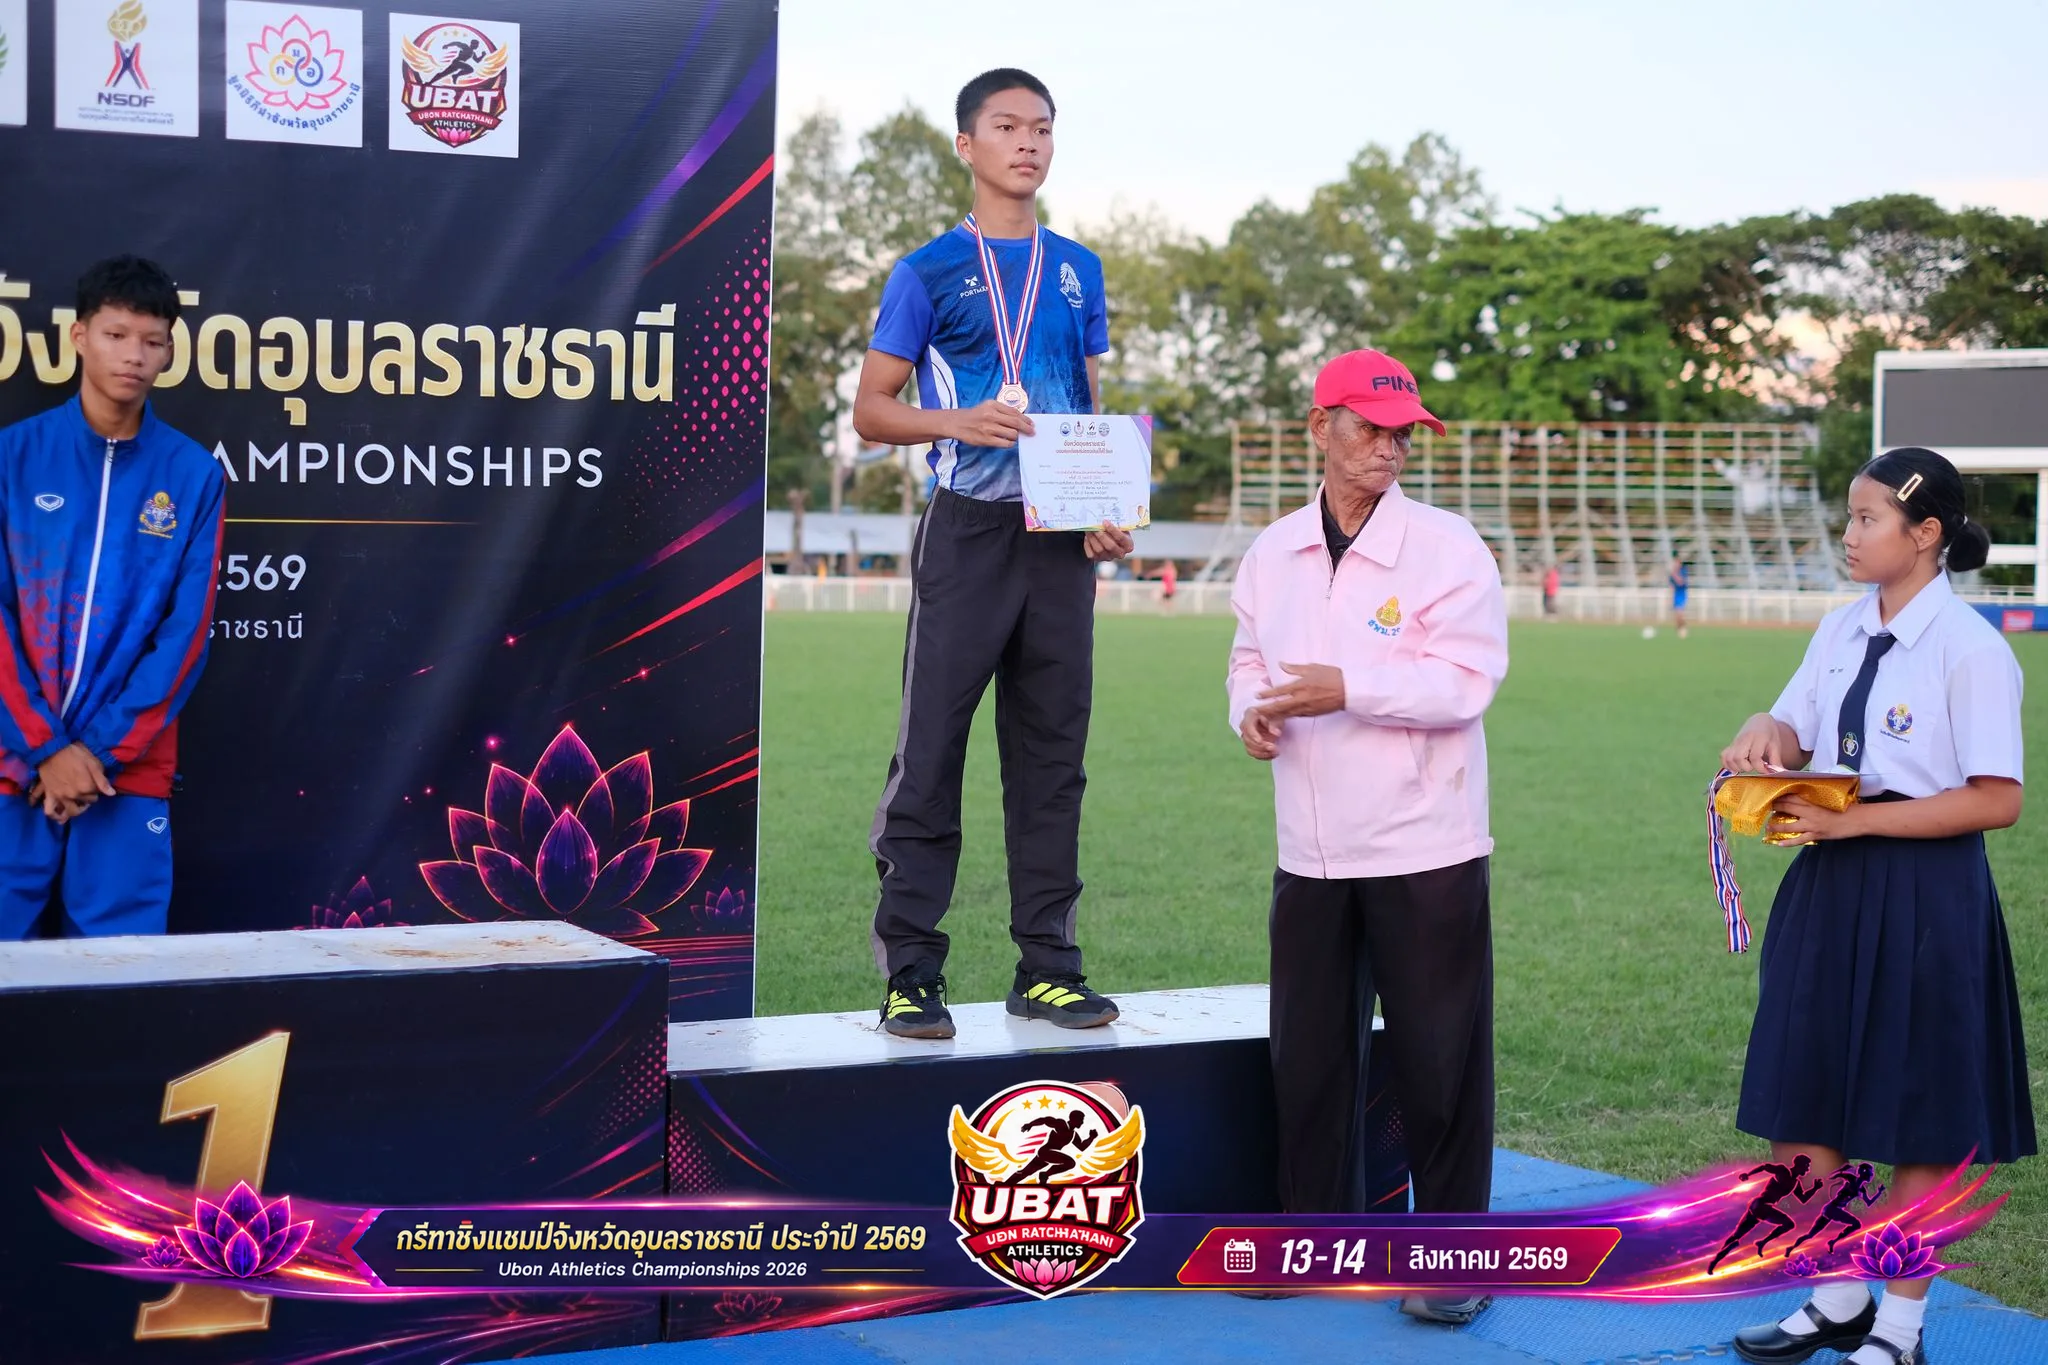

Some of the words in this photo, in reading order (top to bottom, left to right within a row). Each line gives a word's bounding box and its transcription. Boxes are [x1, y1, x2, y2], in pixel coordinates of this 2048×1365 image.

[97, 92, 155, 108] NSDF
[410, 84, 499, 113] UBAT
[418, 111, 440, 120] UBON
[441, 111, 493, 125] RATCHATHANI
[433, 121, 477, 129] ATHLETICS
[212, 440, 603, 488] AMPIONSHIPS
[216, 554, 307, 592] 569
[134, 1031, 291, 1340] 1
